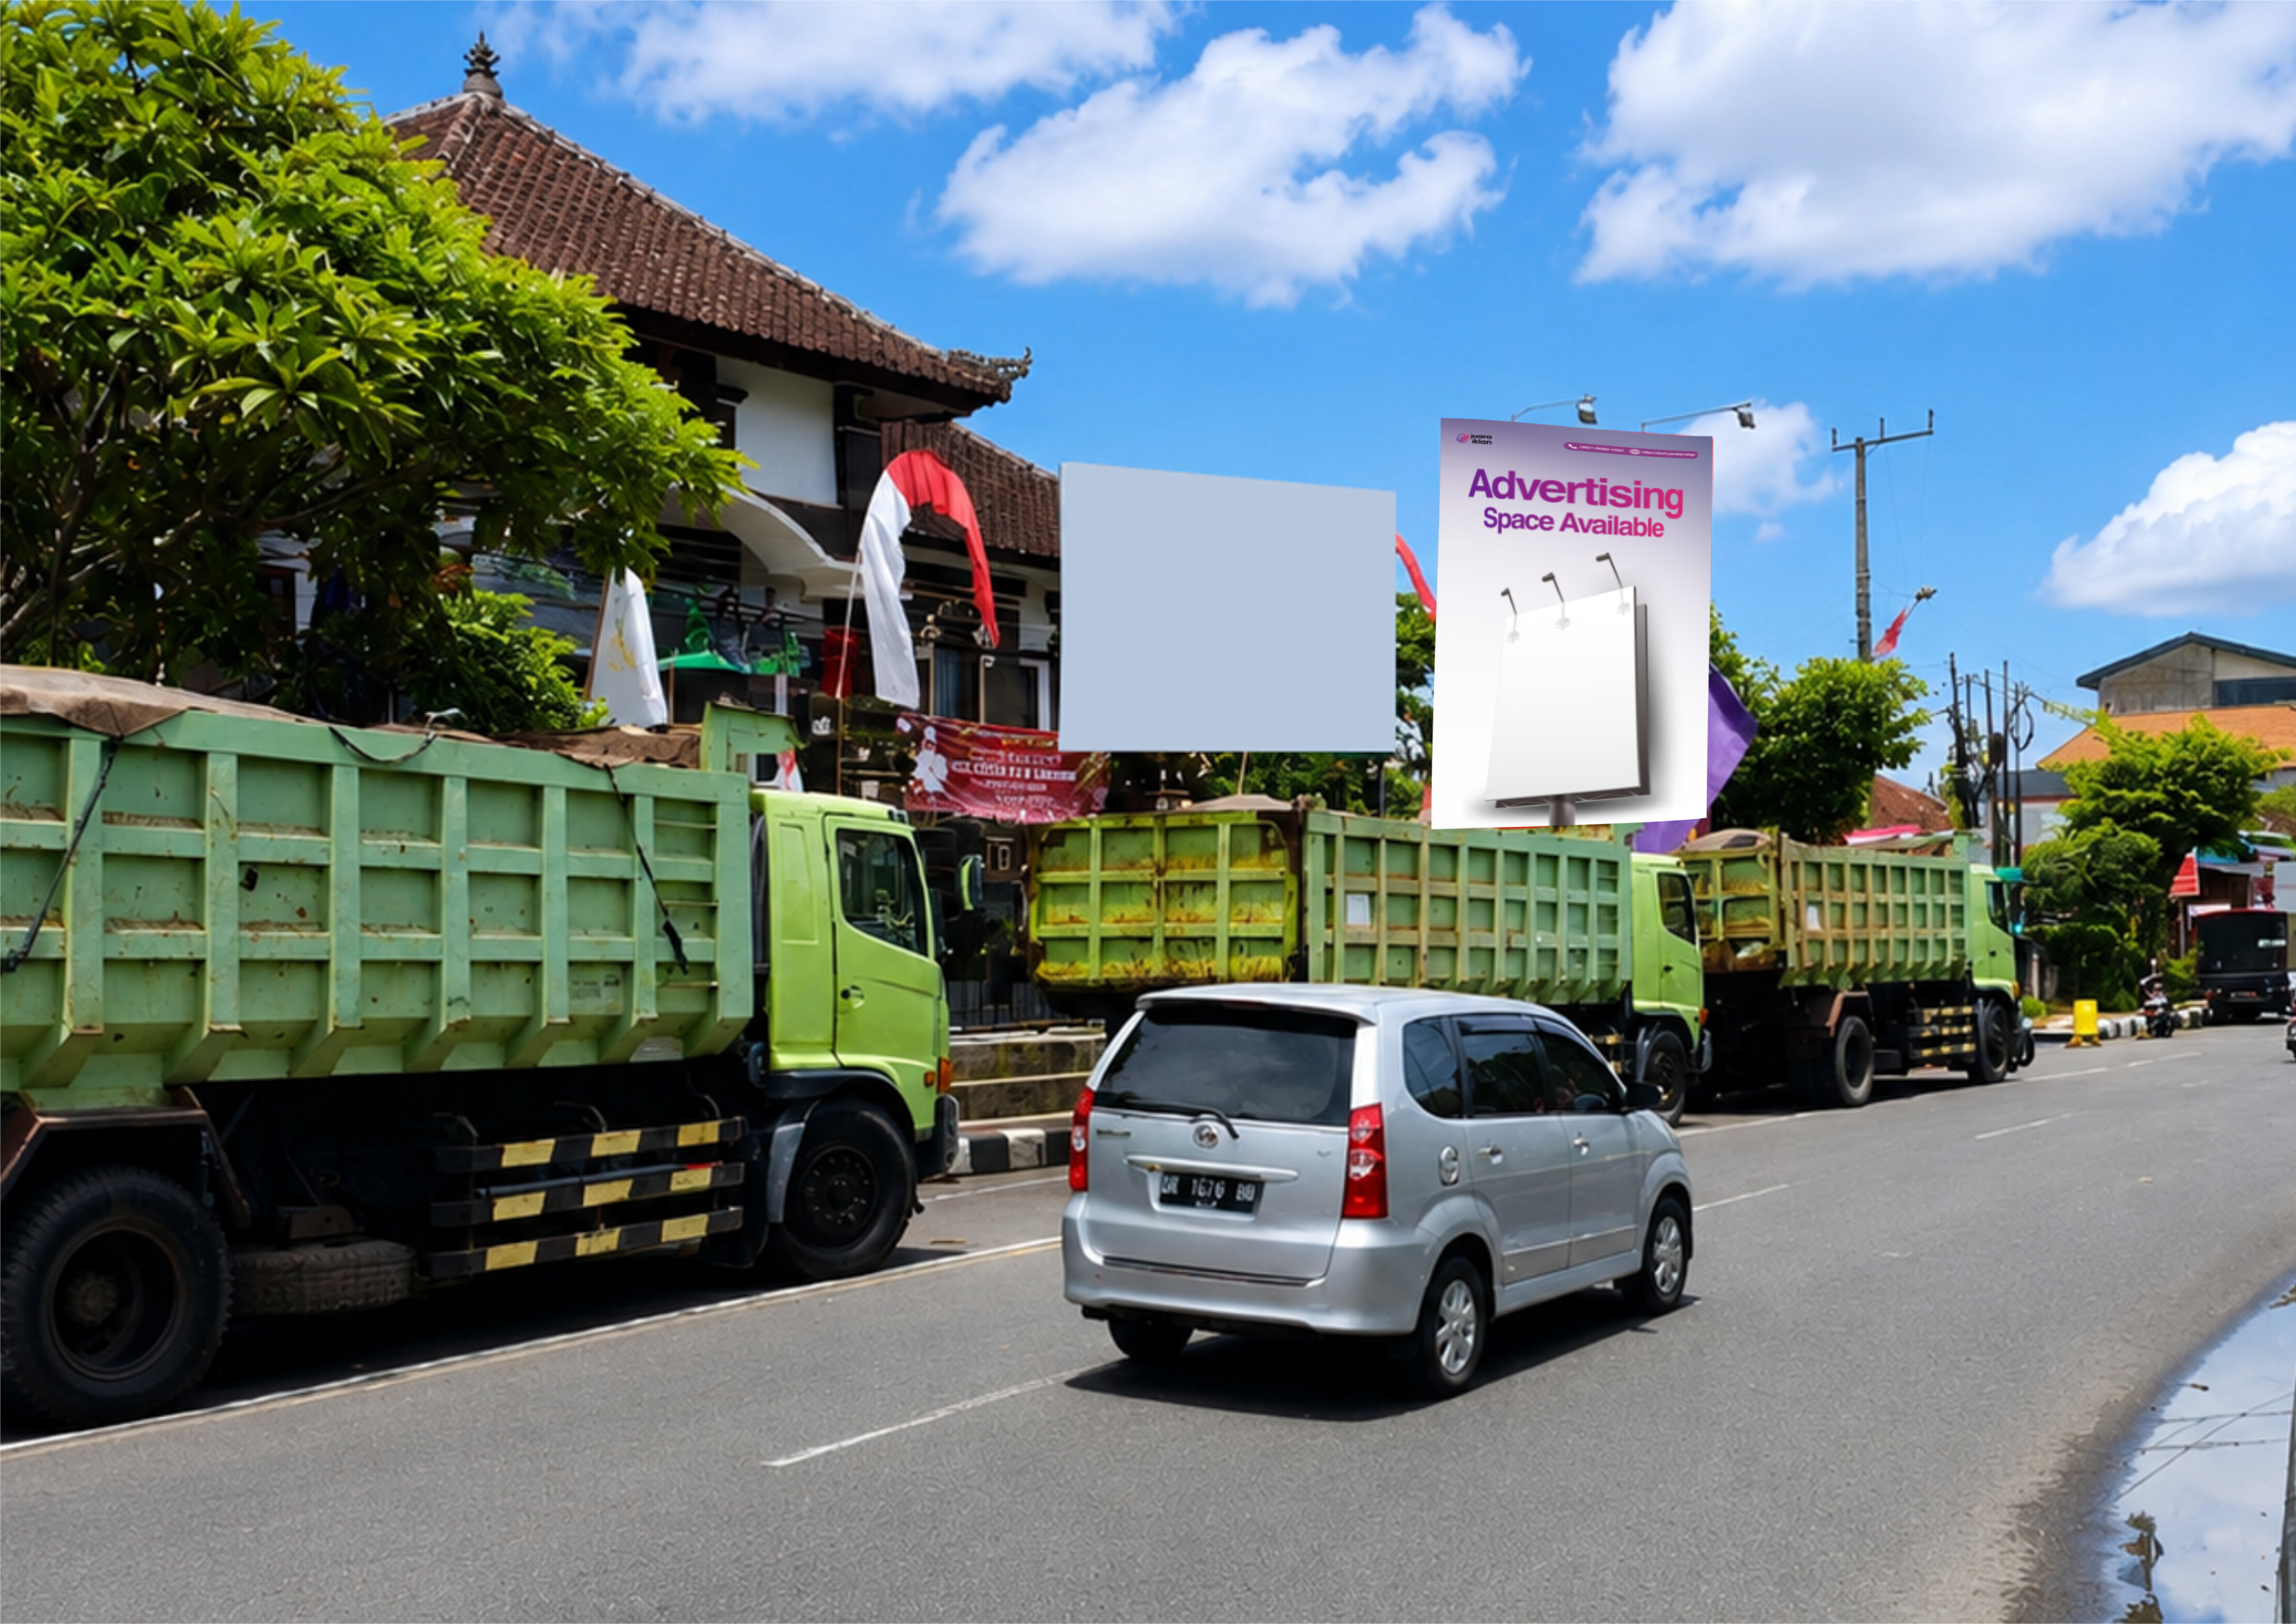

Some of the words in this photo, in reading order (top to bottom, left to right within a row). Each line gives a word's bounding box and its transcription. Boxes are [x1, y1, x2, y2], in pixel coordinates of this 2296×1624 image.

[1468, 468, 1684, 519] Advertising
[1483, 506, 1555, 534] Space
[1559, 512, 1665, 537] Available
